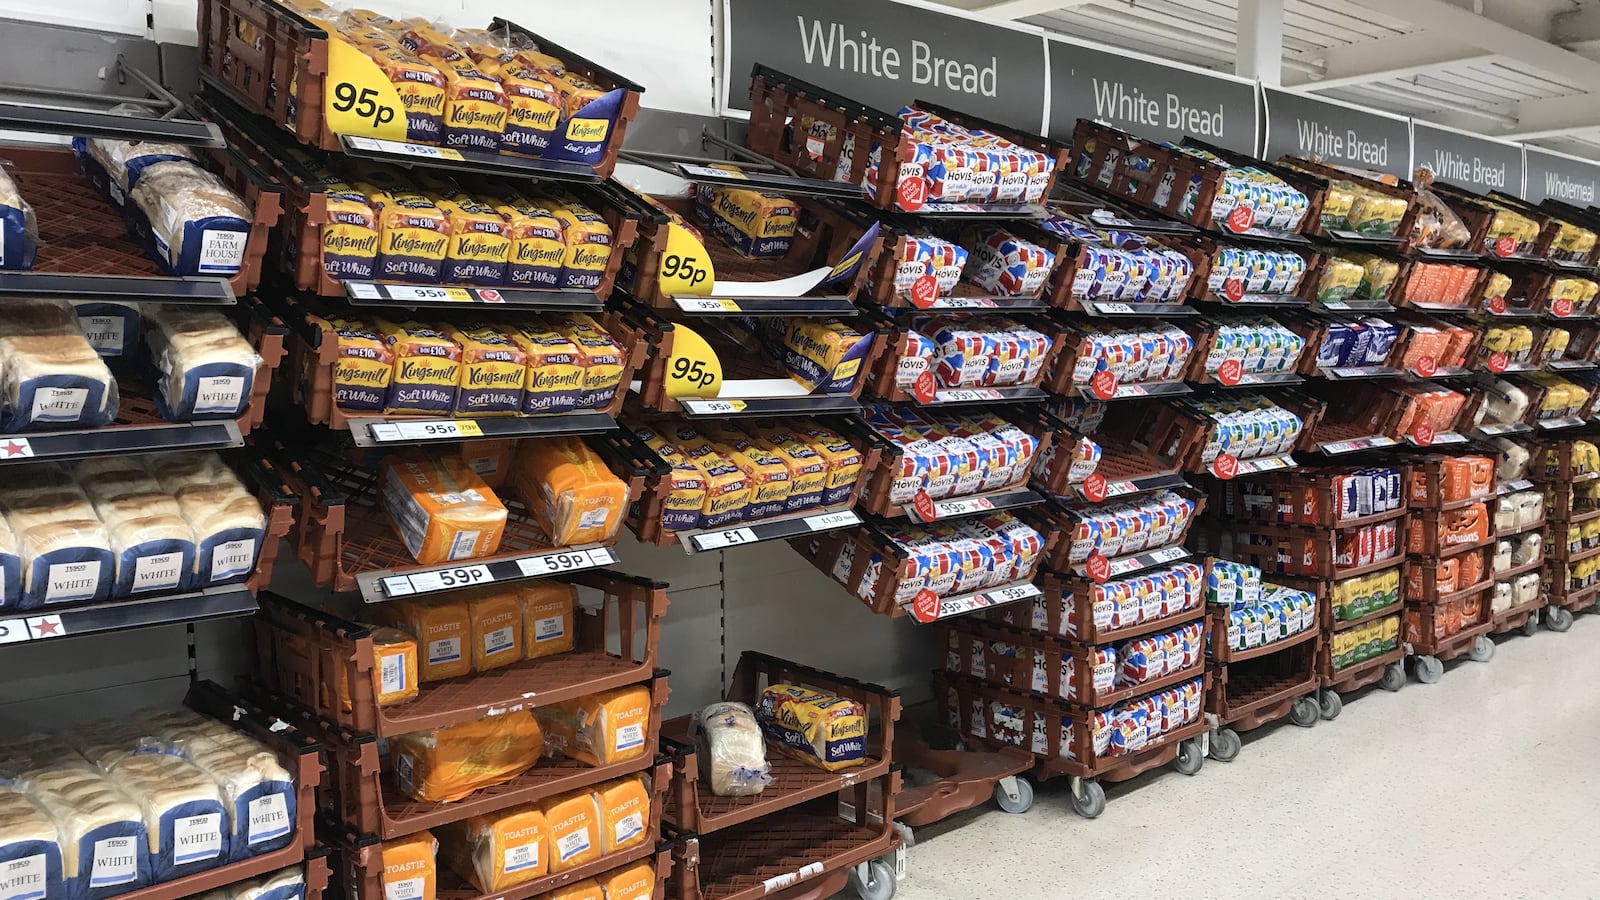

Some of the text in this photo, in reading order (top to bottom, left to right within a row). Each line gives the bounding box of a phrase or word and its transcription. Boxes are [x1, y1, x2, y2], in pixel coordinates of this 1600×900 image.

[797, 15, 997, 98] White Bread
[332, 82, 395, 128] 95p
[1092, 78, 1225, 137] White Bread
[451, 103, 506, 129] Kingsmill
[571, 123, 605, 137] Kingsmill
[447, 132, 498, 149] Soft White
[521, 132, 550, 148] White
[1297, 118, 1388, 167] White Bread
[404, 144, 437, 155] 95p
[1435, 149, 1505, 187] White Bread
[947, 169, 972, 181] HOVIS
[1002, 175, 1025, 185] HOVIS
[1545, 171, 1595, 202] Wholemeal
[1215, 196, 1234, 206] HOVIS
[718, 191, 758, 228] Kingsmill
[763, 218, 797, 235] Kingsmill
[209, 240, 238, 249] FARM
[389, 232, 446, 256] Kingsmill
[457, 237, 510, 259] Kingsmill
[759, 240, 774, 252] Soft
[205, 249, 239, 259] HOUSE
[516, 242, 566, 266] Kingsmill
[342, 262, 371, 276] White
[385, 261, 437, 276] Soft White
[453, 265, 501, 279] Soft White
[662, 254, 707, 286] 95p
[935, 269, 959, 278] HOVIS
[1027, 269, 1048, 278] HOVIS
[512, 270, 557, 284] Soft White
[567, 275, 586, 286] Soft
[415, 288, 446, 298] 95p
[699, 301, 721, 309] 95p
[790, 325, 830, 365] Kingsmill
[785, 351, 820, 380] Soft White
[964, 357, 987, 368] HOVIS
[1000, 361, 1023, 371] HOVIS
[1152, 356, 1169, 365] HOVIS
[400, 361, 458, 382] Kingsmill
[469, 367, 524, 386] Kingsmill
[671, 356, 715, 388] 95p
[533, 370, 581, 388] Kingsmill
[349, 389, 379, 403] White
[398, 389, 450, 403] Soft White
[468, 393, 518, 406] Soft White
[530, 395, 576, 409] Soft White
[949, 391, 974, 400] 99p
[39, 400, 79, 411] WHITE
[708, 403, 731, 411] 95p
[424, 425, 457, 435] 95p
[1072, 461, 1095, 471] HOVIS
[960, 473, 982, 484] HOVIS
[989, 470, 1010, 479] HOVIS
[790, 476, 826, 493] Kingsmill
[930, 477, 953, 488] HOVIS
[756, 486, 791, 500] Kingsmill
[585, 496, 615, 505] TOASTIE
[710, 492, 750, 513] Kingsmill
[787, 499, 802, 509] Soft
[940, 501, 966, 512] 99p
[675, 512, 695, 524] White
[723, 530, 746, 543] £1
[1126, 534, 1146, 543] HOVIS
[1152, 527, 1170, 537] HOVIS
[1072, 541, 1093, 549] HOVIS
[1103, 539, 1120, 548] HOVIS
[217, 553, 250, 568] WHITE
[1161, 548, 1182, 560] 99p
[543, 553, 583, 571] 59p
[140, 568, 177, 581] WHITE
[440, 565, 482, 586] 59p
[931, 575, 954, 587] HOVIS
[54, 577, 94, 591] WHITE
[1219, 581, 1236, 591] HOVIS
[1244, 577, 1259, 588] HOVIS
[1002, 587, 1026, 599] 99p
[1144, 593, 1160, 606] HOVIS
[1168, 588, 1185, 599] HOVIS
[535, 601, 564, 613] TOASTIE
[1120, 600, 1139, 611] HOVIS
[482, 612, 513, 627] TOASTIE
[429, 622, 461, 634] TOASTIE
[1169, 646, 1184, 658] HOVIS
[1093, 666, 1113, 676] HOVIS
[615, 707, 643, 721] TOASTIE
[1169, 703, 1184, 715] HOVIS
[830, 719, 862, 738] Kingsmill
[1095, 726, 1114, 741] HOVIS
[1127, 729, 1146, 743] HOVIS
[831, 741, 862, 757] Soft White
[611, 797, 640, 816] TOASTIE
[189, 817, 208, 825] TESCO
[252, 810, 284, 826] WHITE
[554, 812, 586, 833] TOASTIE
[179, 832, 218, 846] WHITE
[504, 826, 538, 840] TOASTIE
[107, 839, 128, 847] TESCO
[8, 860, 31, 870] TESCO
[385, 860, 426, 873] TOASTIE
[0, 873, 41, 891] WHITE
[618, 879, 648, 896] TOASTIE
